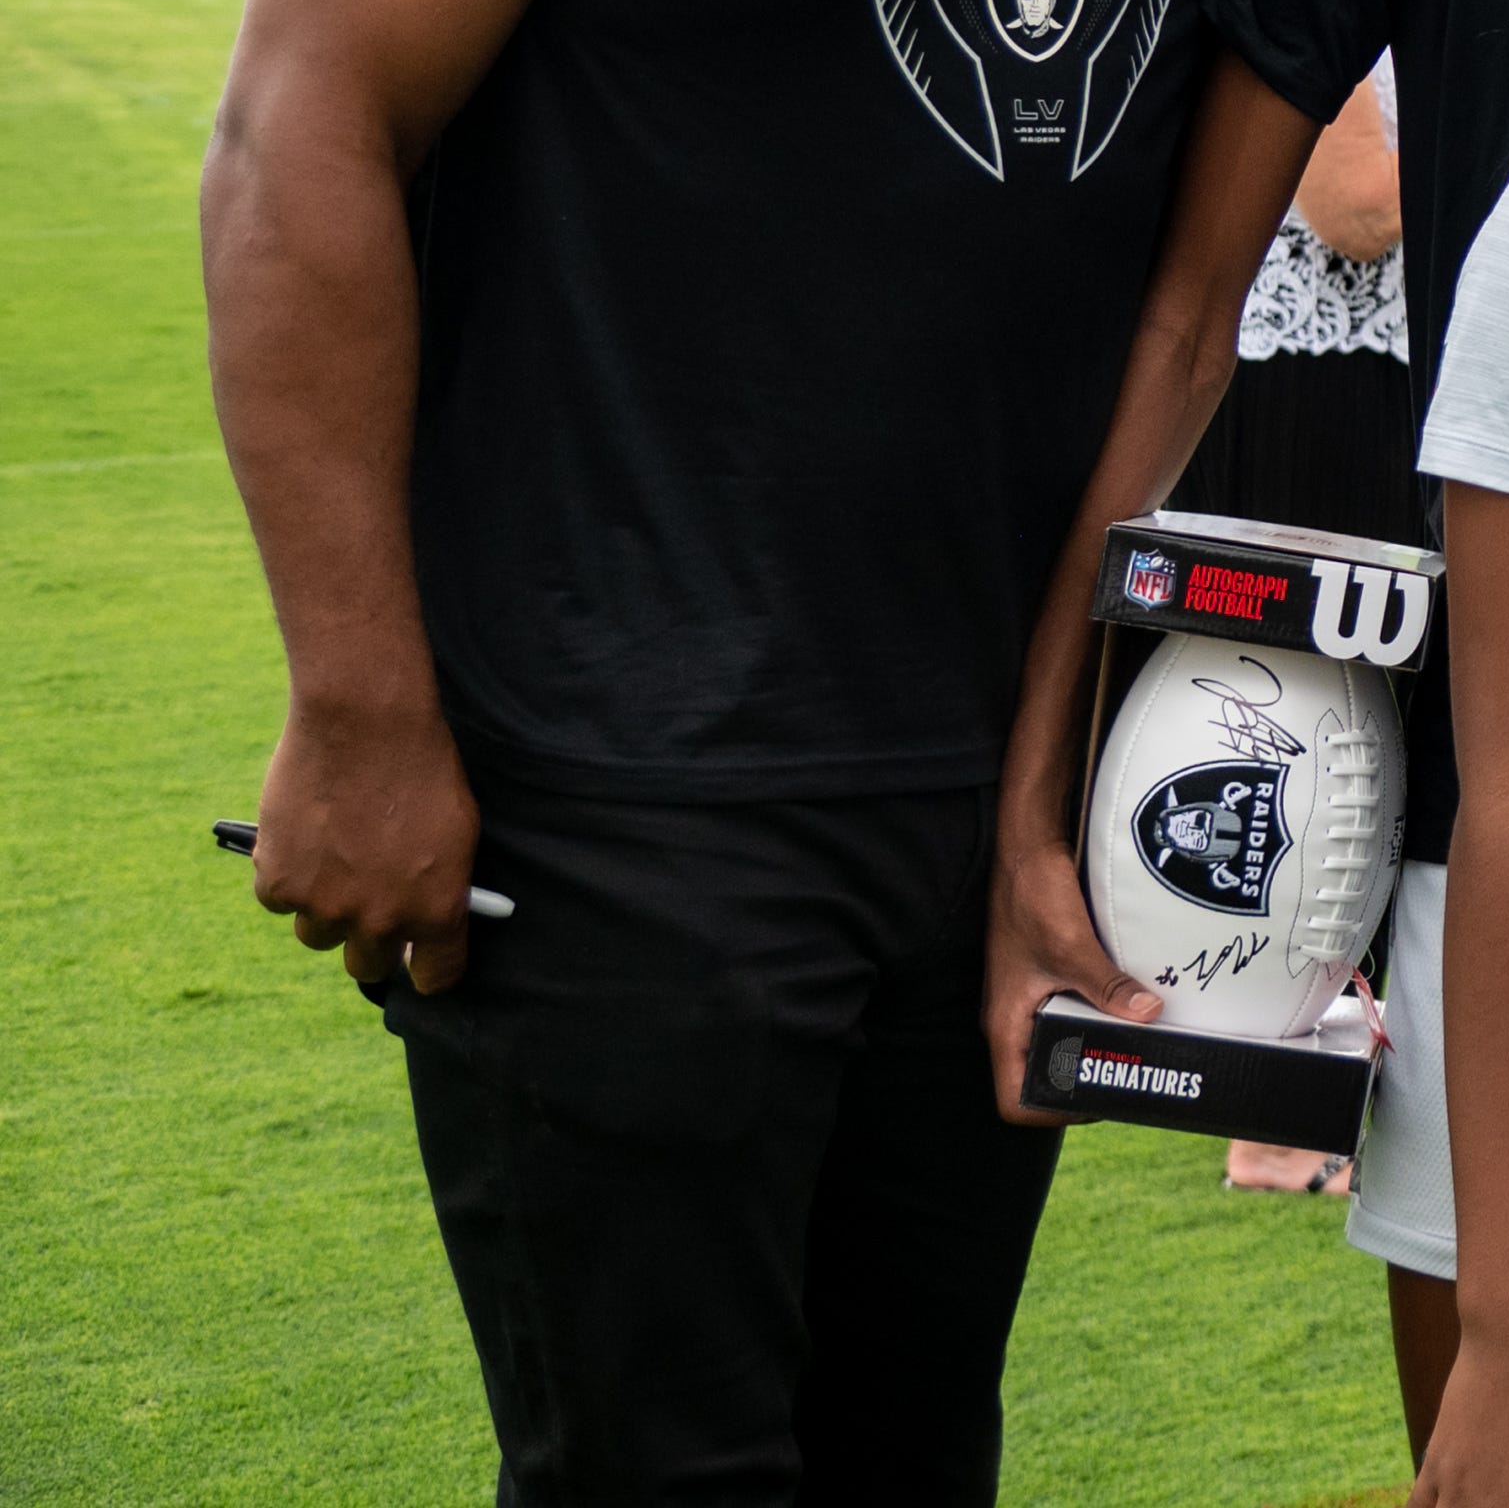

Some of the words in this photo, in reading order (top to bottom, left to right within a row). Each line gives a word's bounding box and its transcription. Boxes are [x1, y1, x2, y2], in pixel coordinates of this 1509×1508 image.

[1013, 98, 1065, 120] LV
[1133, 570, 1172, 602] NFL
[1188, 564, 1289, 601] AUTOGRAPH
[1184, 587, 1263, 621] FOOTBALL
[1241, 782, 1275, 898] RAIDERS
[1079, 1057, 1203, 1099] SIGNATURES
